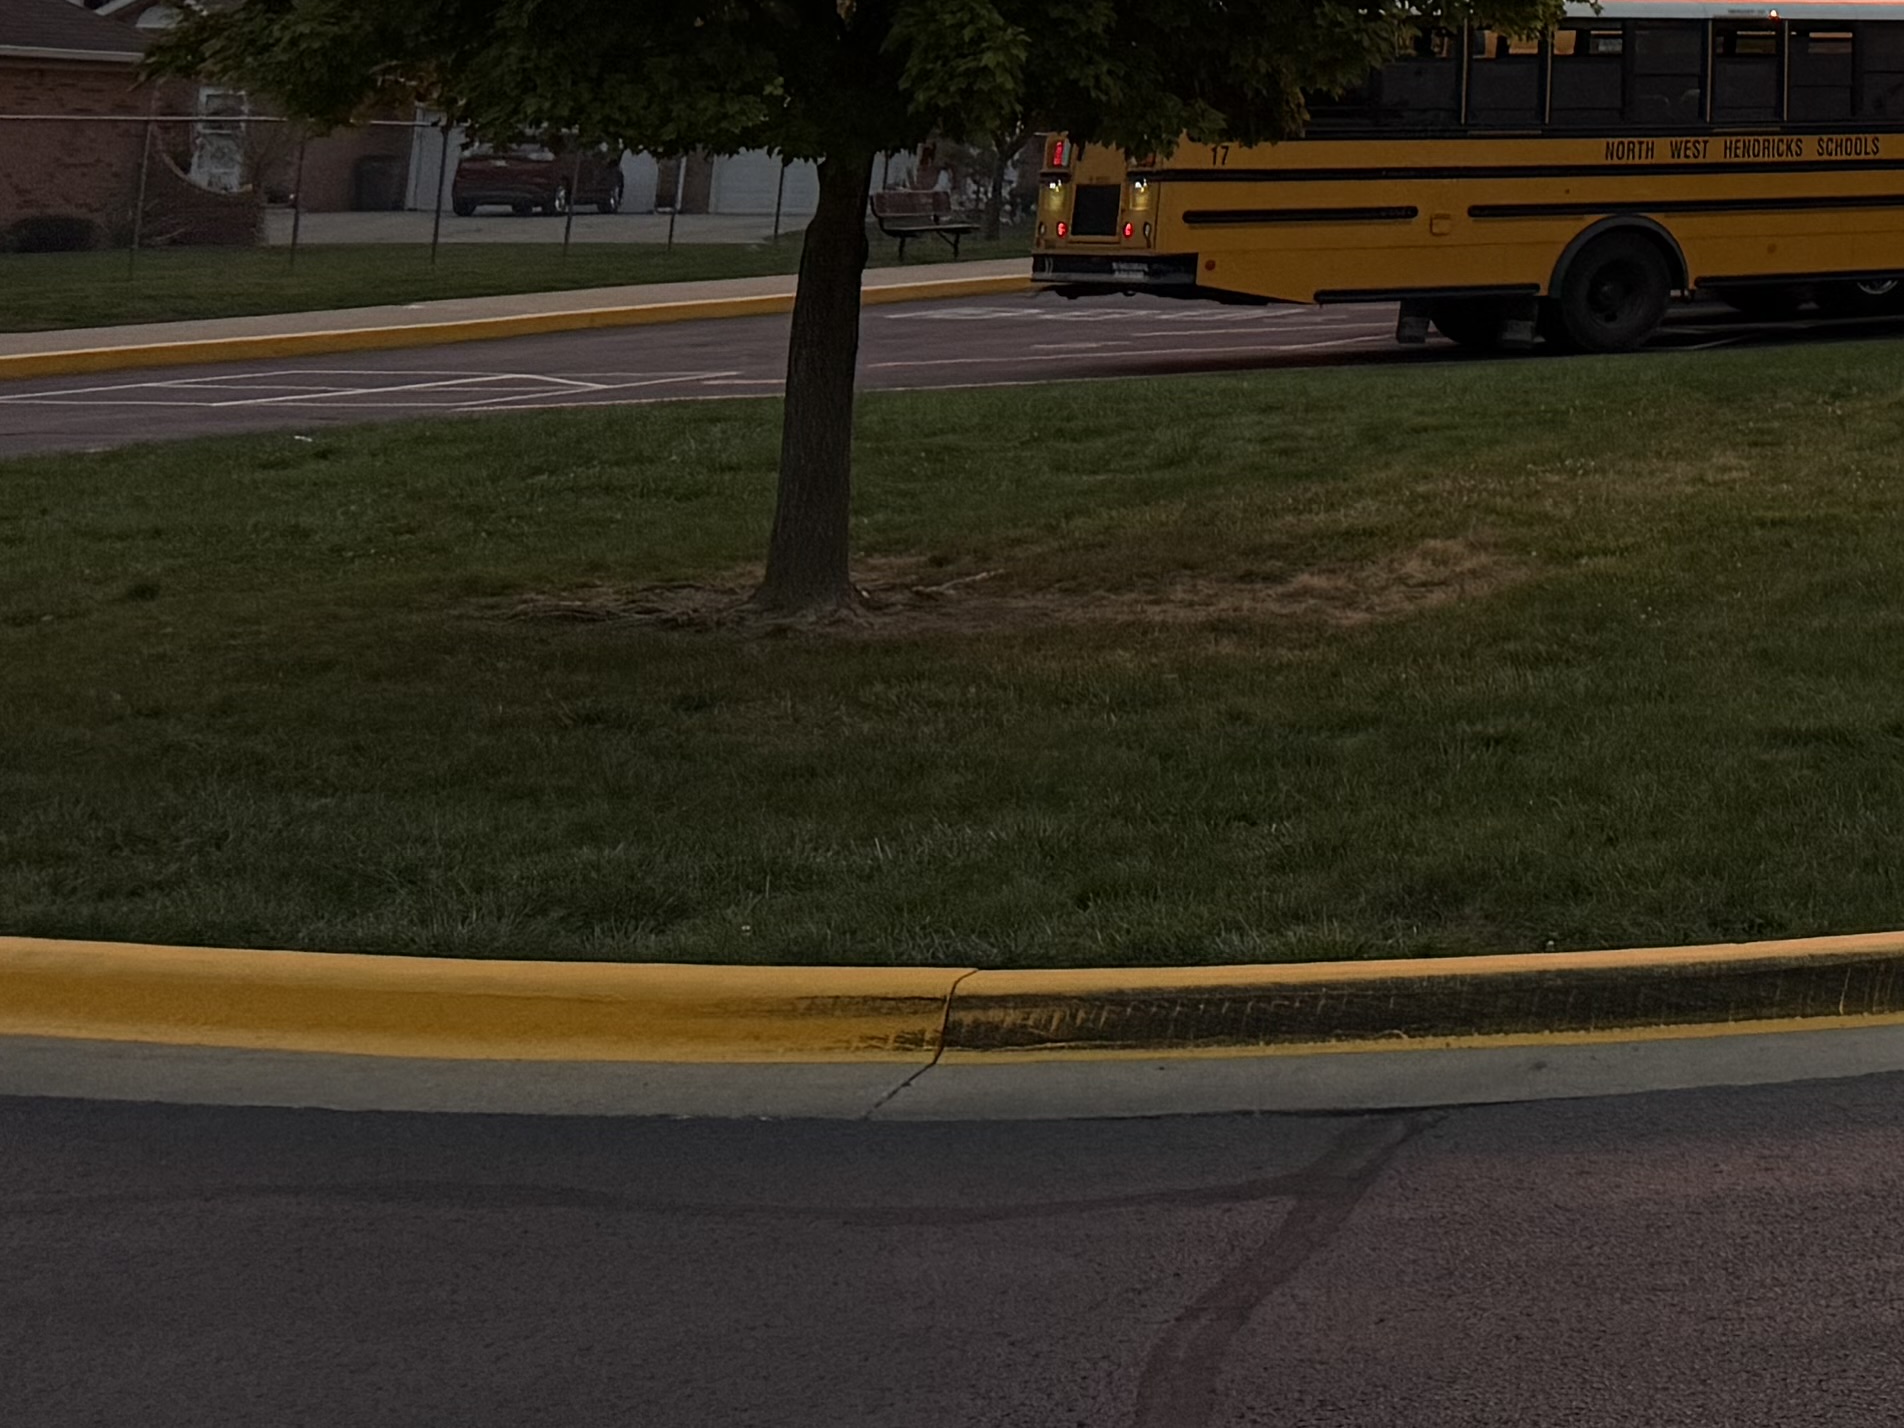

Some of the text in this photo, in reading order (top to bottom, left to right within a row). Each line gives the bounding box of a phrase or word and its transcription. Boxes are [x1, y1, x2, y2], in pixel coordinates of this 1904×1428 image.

[1211, 145, 1229, 165] 17
[1605, 136, 1880, 161] NORTH WEST HENDRICKS SCHOOLS
